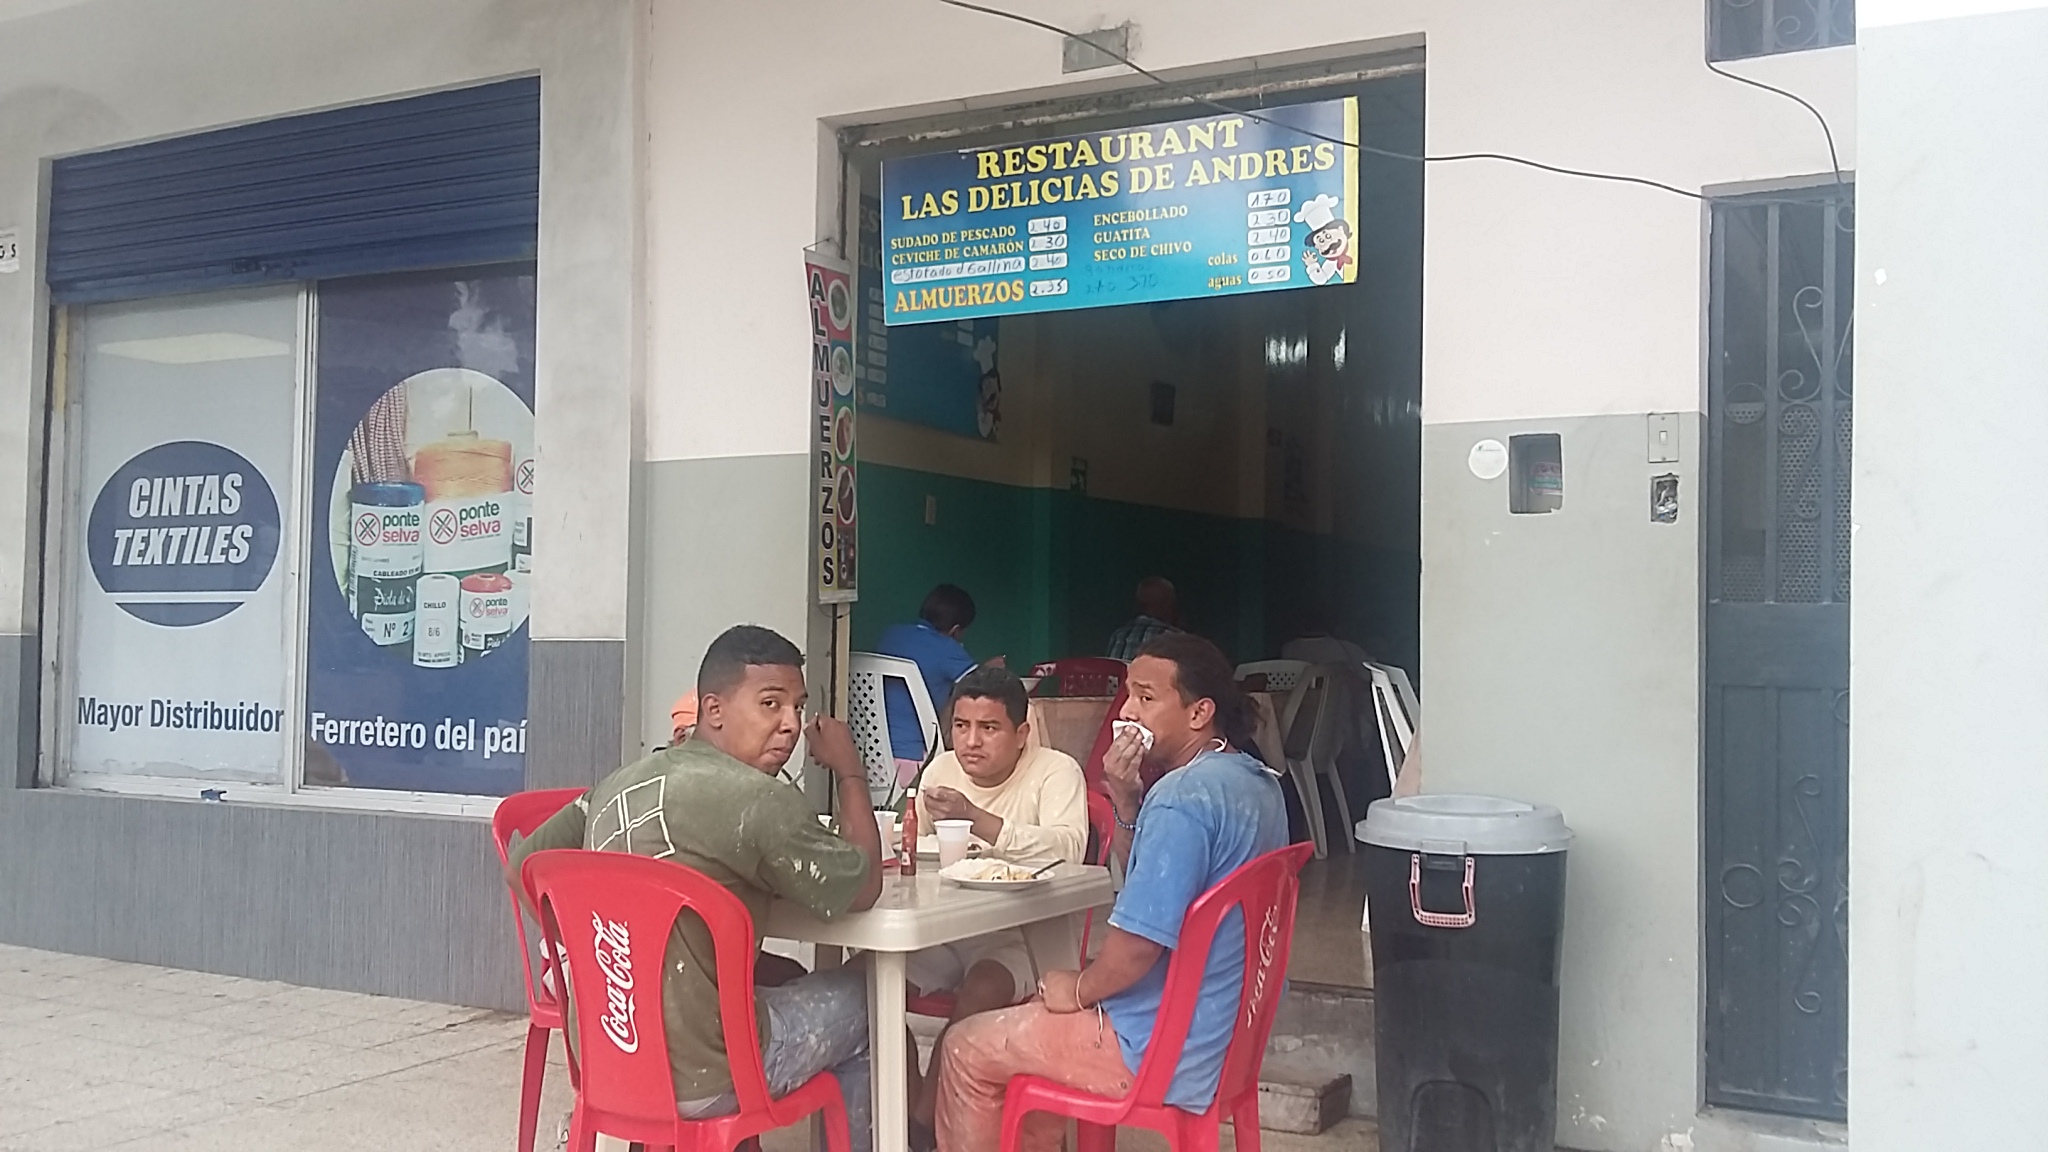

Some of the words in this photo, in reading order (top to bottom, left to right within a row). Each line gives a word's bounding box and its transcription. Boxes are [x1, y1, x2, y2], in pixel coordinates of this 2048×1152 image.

[976, 118, 1244, 179] RESTAURANT
[902, 190, 958, 220] LAS
[968, 170, 1119, 213] DELICIAS
[1129, 163, 1175, 194] DE
[1186, 142, 1336, 187] ANDRES
[1094, 205, 1188, 226] ENCEBOLLADO
[891, 233, 939, 249] SUDADO
[942, 231, 957, 244] DE
[960, 225, 1016, 241] PESCADO
[1094, 227, 1150, 244] GUATITA
[892, 250, 941, 265] CEVICHE
[944, 247, 960, 260] DE
[963, 240, 1024, 257] CAMARÓN
[1094, 247, 1126, 261] SECO
[1130, 246, 1147, 258] DE
[1150, 241, 1192, 256] CHIVO
[1208, 253, 1238, 266] colas
[1208, 274, 1242, 290] aguas
[894, 280, 1024, 313] ALMUERZOS
[809, 268, 834, 587] ALMUERZOS
[128, 473, 242, 518] CINTAS
[382, 512, 420, 530] ponte
[459, 500, 500, 525] ponte
[382, 528, 420, 543] selva
[460, 519, 501, 538] selva
[112, 524, 253, 566] TEXTILES
[373, 569, 408, 577] CABLEADO
[423, 601, 447, 609] CHILLO
[486, 598, 508, 608] ponte
[486, 606, 508, 616] selva
[428, 627, 440, 637] 8/6
[78, 697, 143, 732] Mayor
[150, 699, 284, 732] Distribuidor
[311, 712, 426, 749] Ferretero
[434, 717, 476, 751] del
[484, 719, 528, 759] paí
[591, 910, 639, 1054] Coca-Cola
